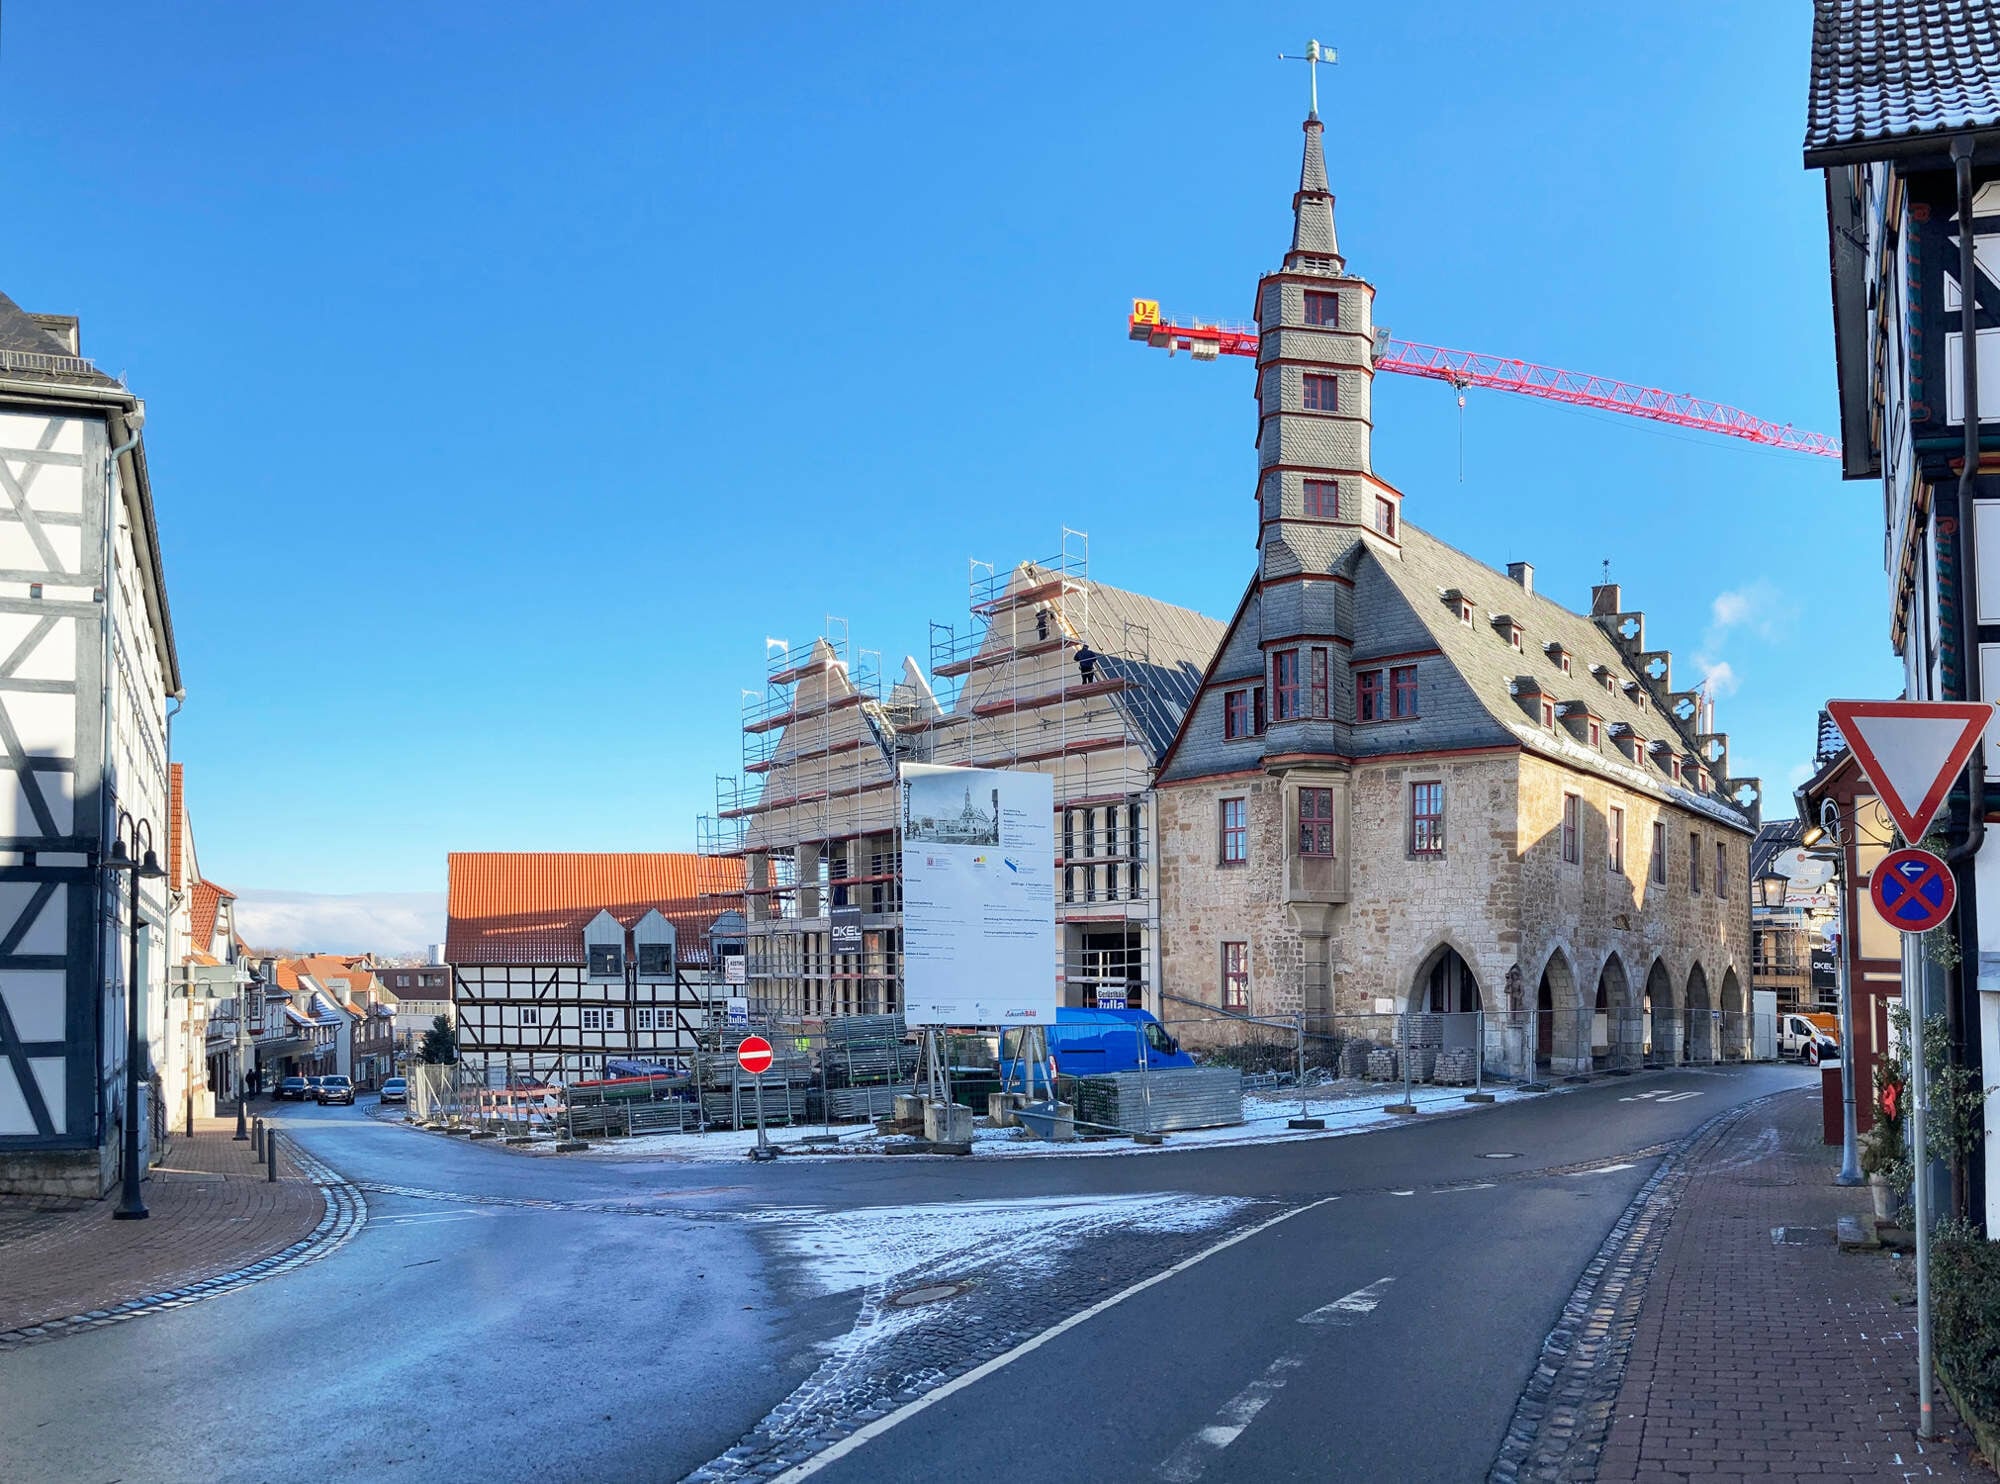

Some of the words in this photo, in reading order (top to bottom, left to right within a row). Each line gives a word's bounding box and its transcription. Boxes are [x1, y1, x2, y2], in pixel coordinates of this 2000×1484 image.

[832, 925, 862, 937] OKEL
[1099, 999, 1125, 1009] tulla
[729, 1015, 746, 1025] tulla
